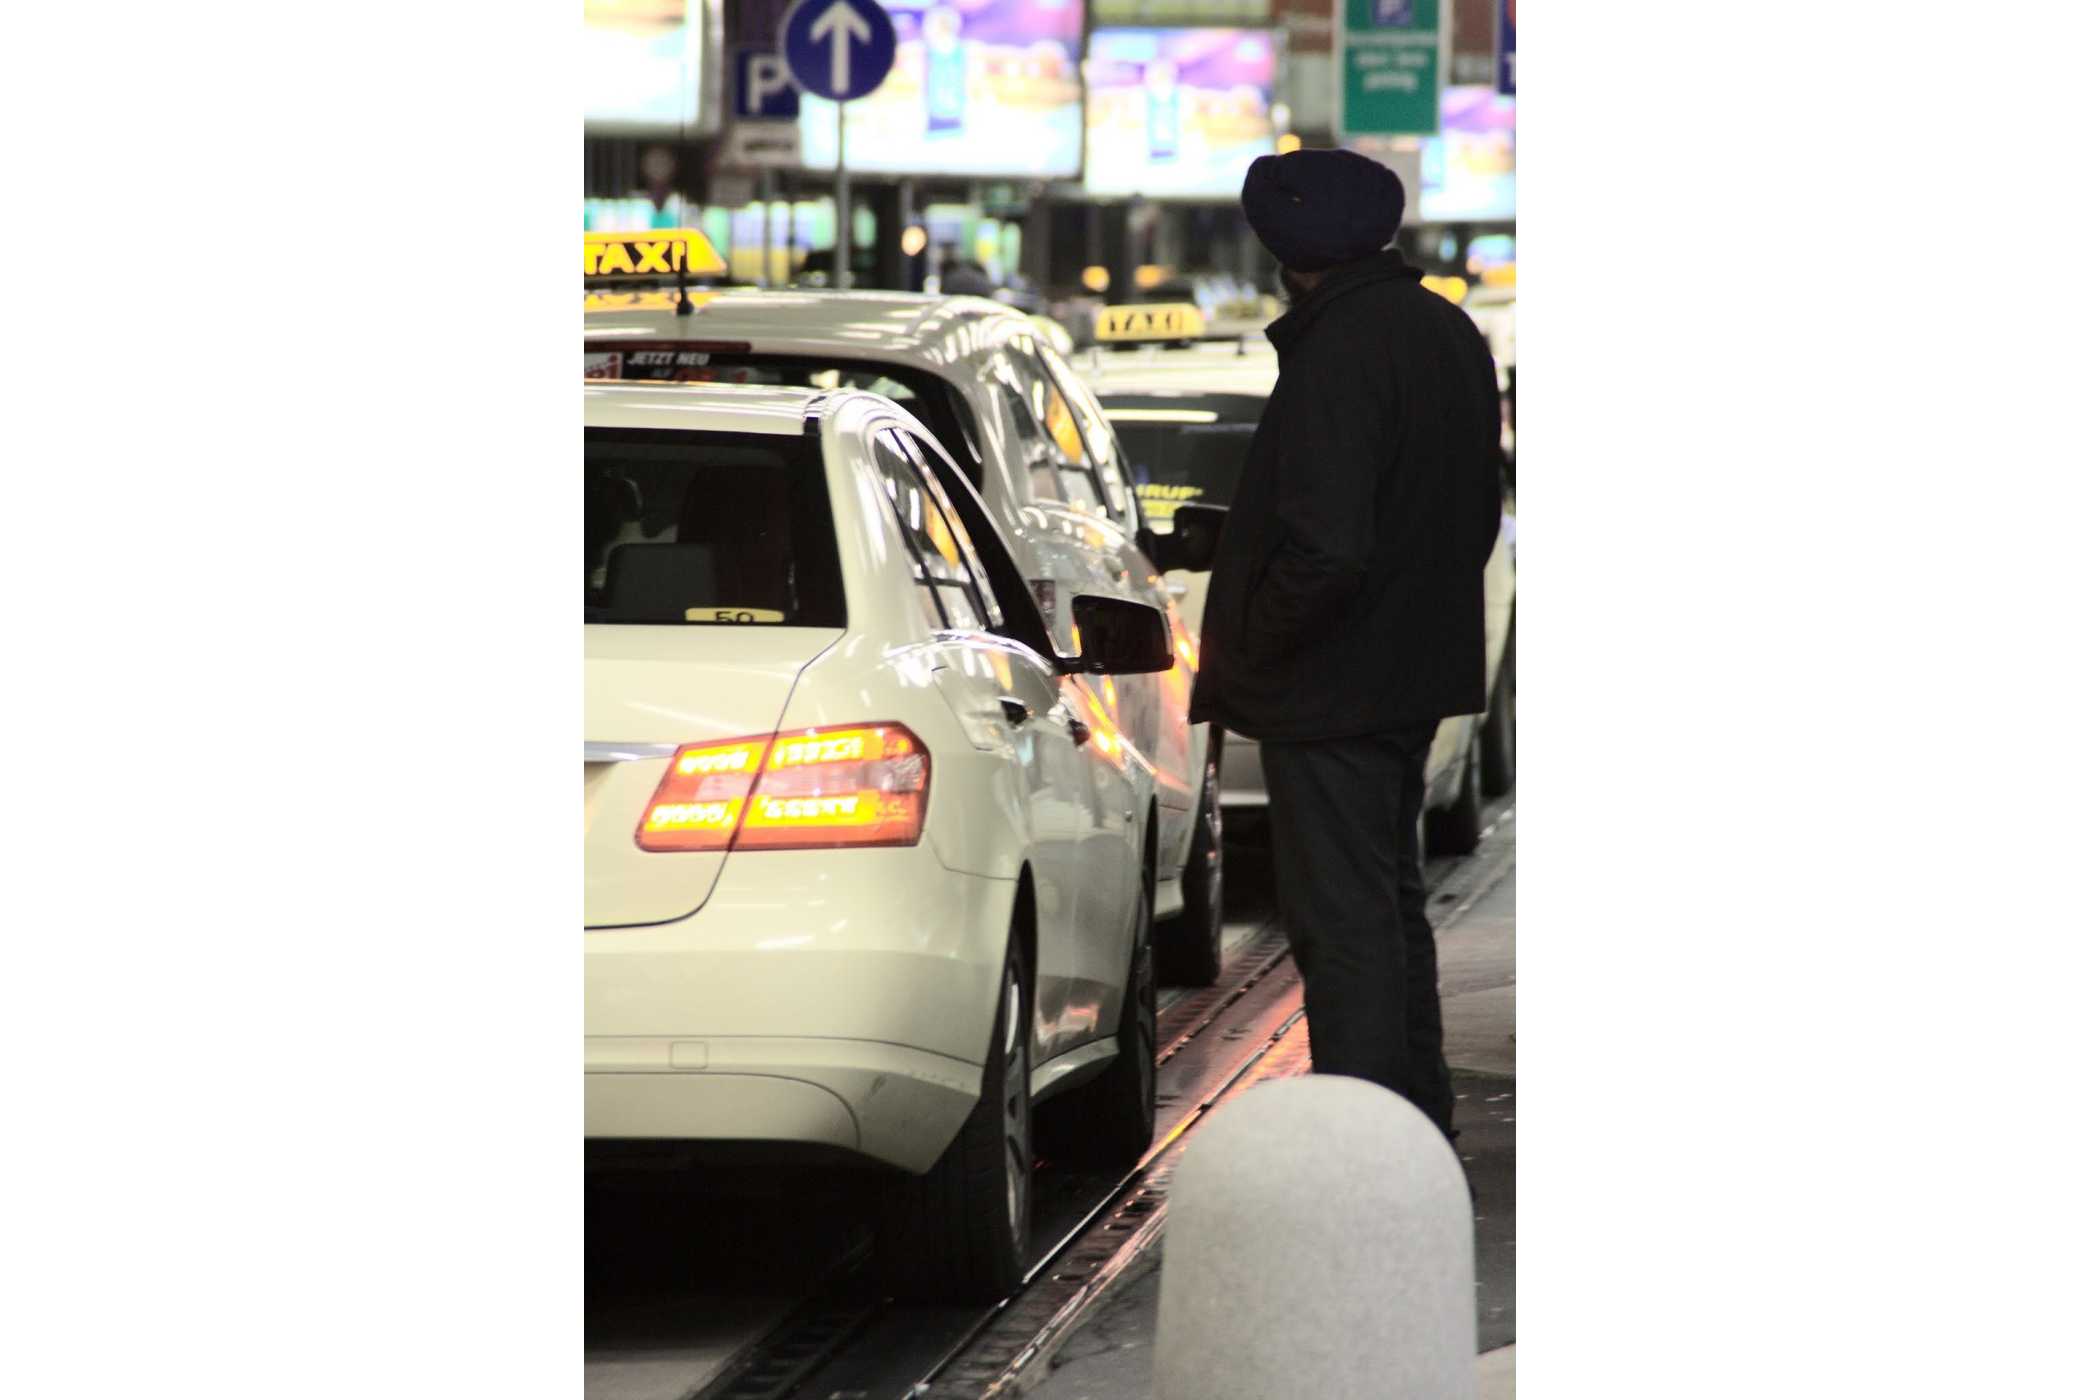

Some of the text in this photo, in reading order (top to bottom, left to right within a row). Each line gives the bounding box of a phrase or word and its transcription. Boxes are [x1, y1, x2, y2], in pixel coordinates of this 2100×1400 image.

[748, 56, 790, 112] P
[584, 241, 687, 274] TAXI
[1104, 312, 1183, 334] TAXI
[627, 351, 675, 366] JETZT
[675, 352, 711, 366] NEU
